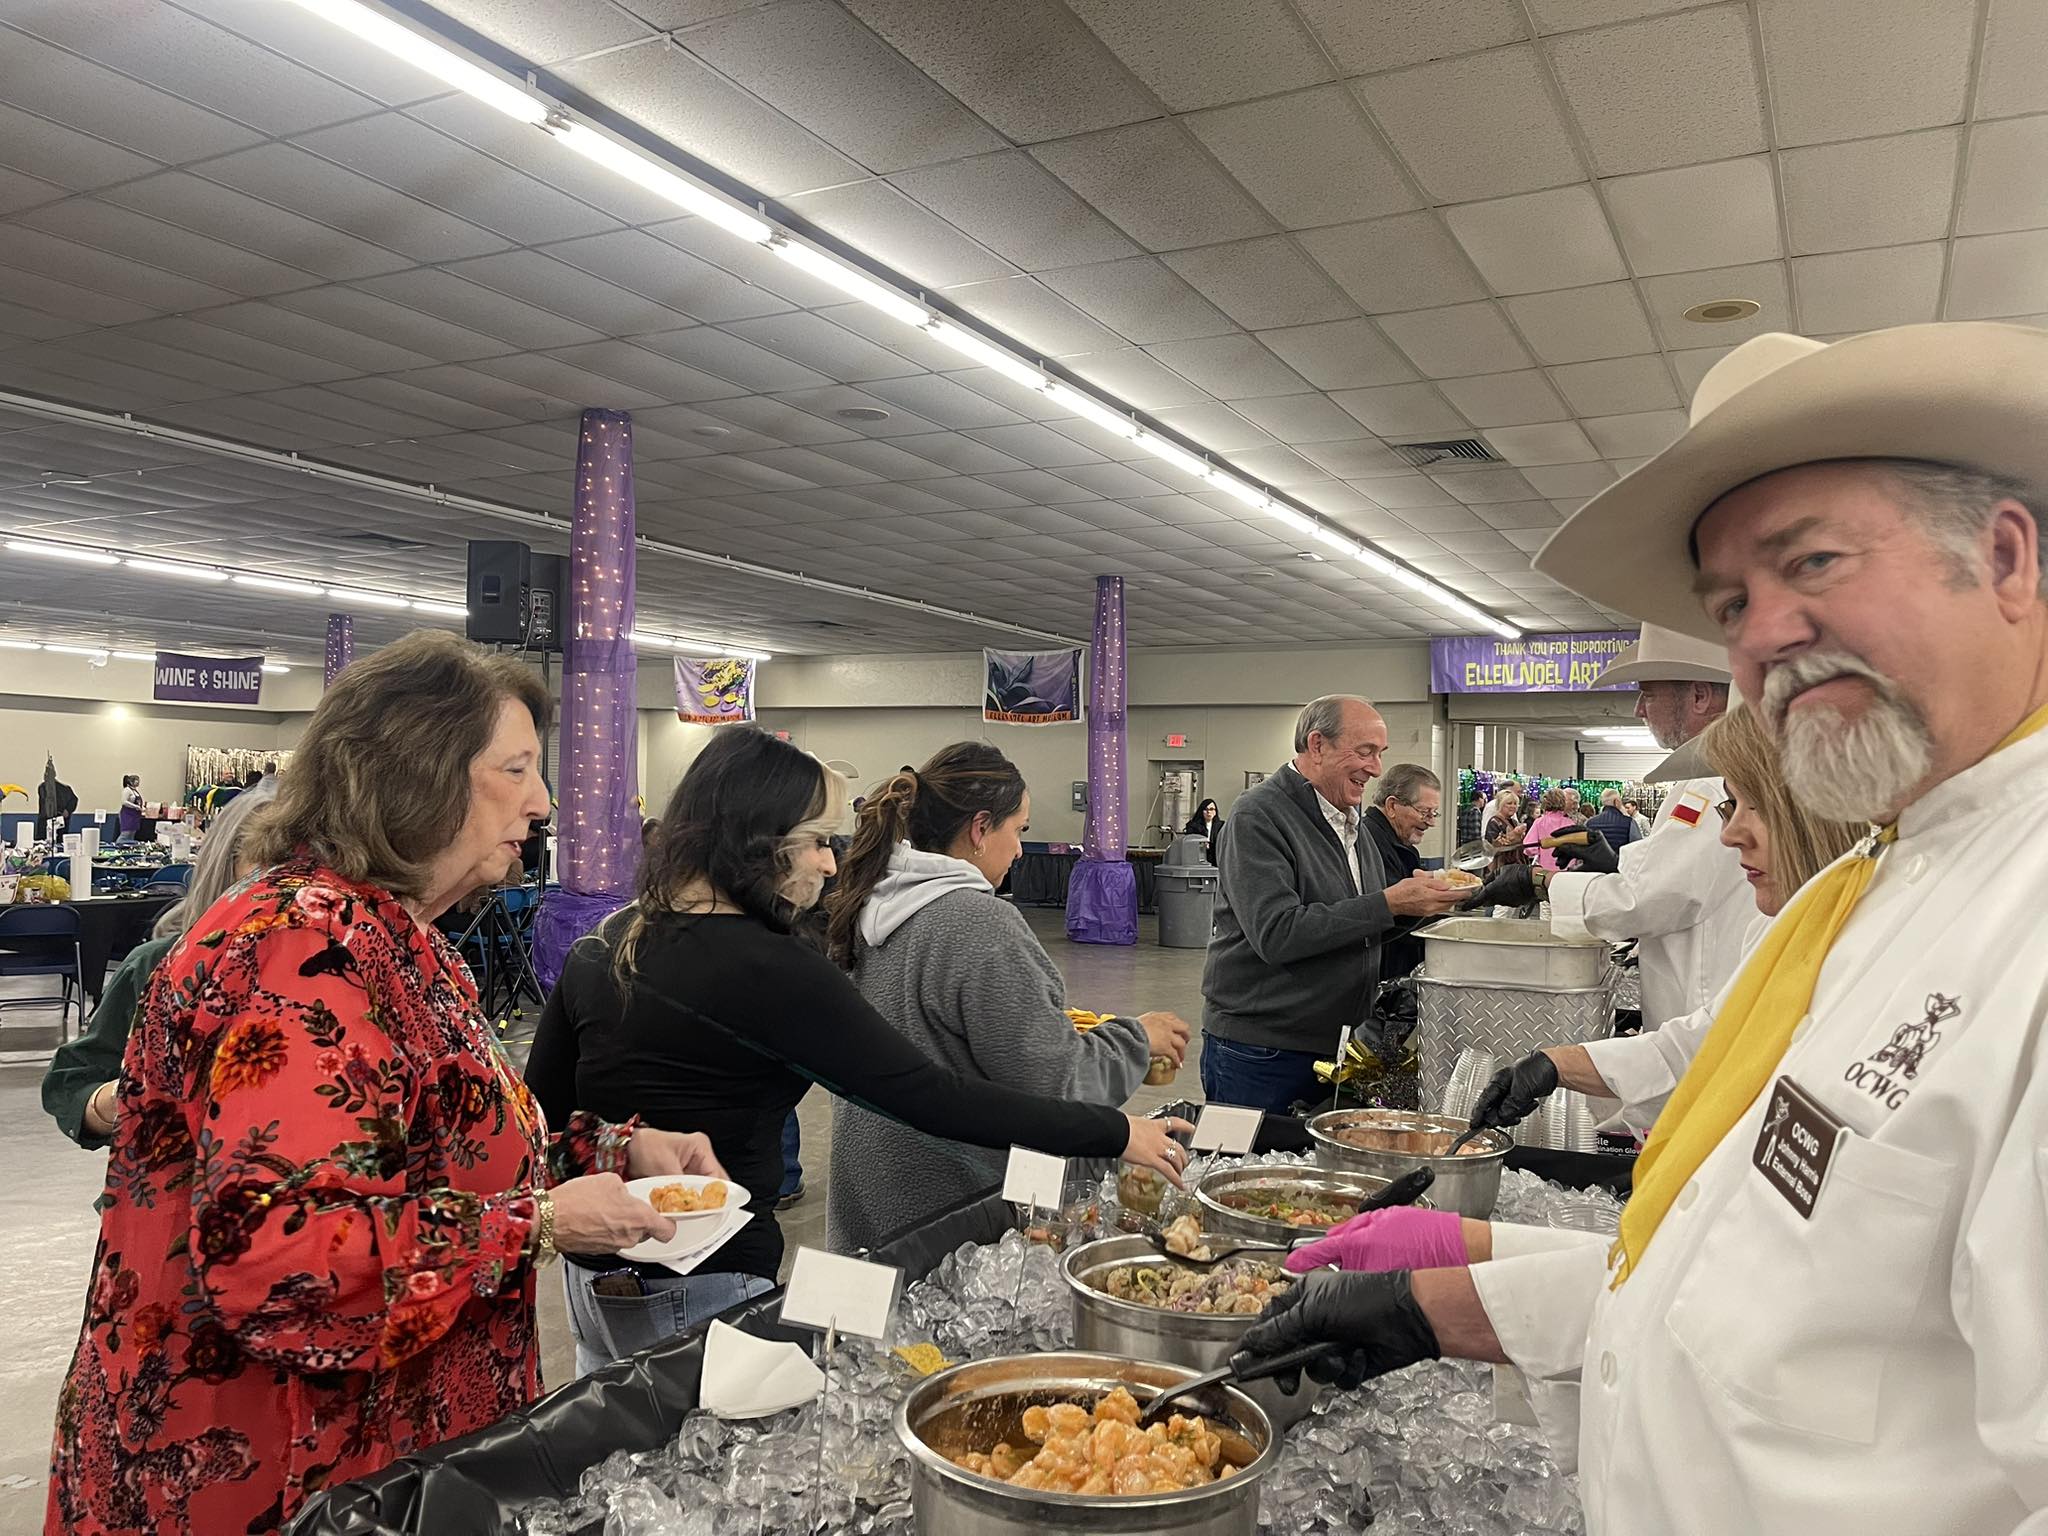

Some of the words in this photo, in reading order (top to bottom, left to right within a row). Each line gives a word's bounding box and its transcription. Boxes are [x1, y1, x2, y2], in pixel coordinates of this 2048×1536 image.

[1494, 642, 1527, 656] THANK
[1529, 641, 1547, 656] YOU
[1550, 641, 1568, 654] FOR
[155, 666, 196, 687] WINE
[199, 669, 208, 689] &
[213, 670, 260, 690] SHINE
[1465, 661, 1514, 686] ELLEN
[1844, 1062, 1910, 1111] OCWG
[1791, 1122, 1819, 1156] OCWG
